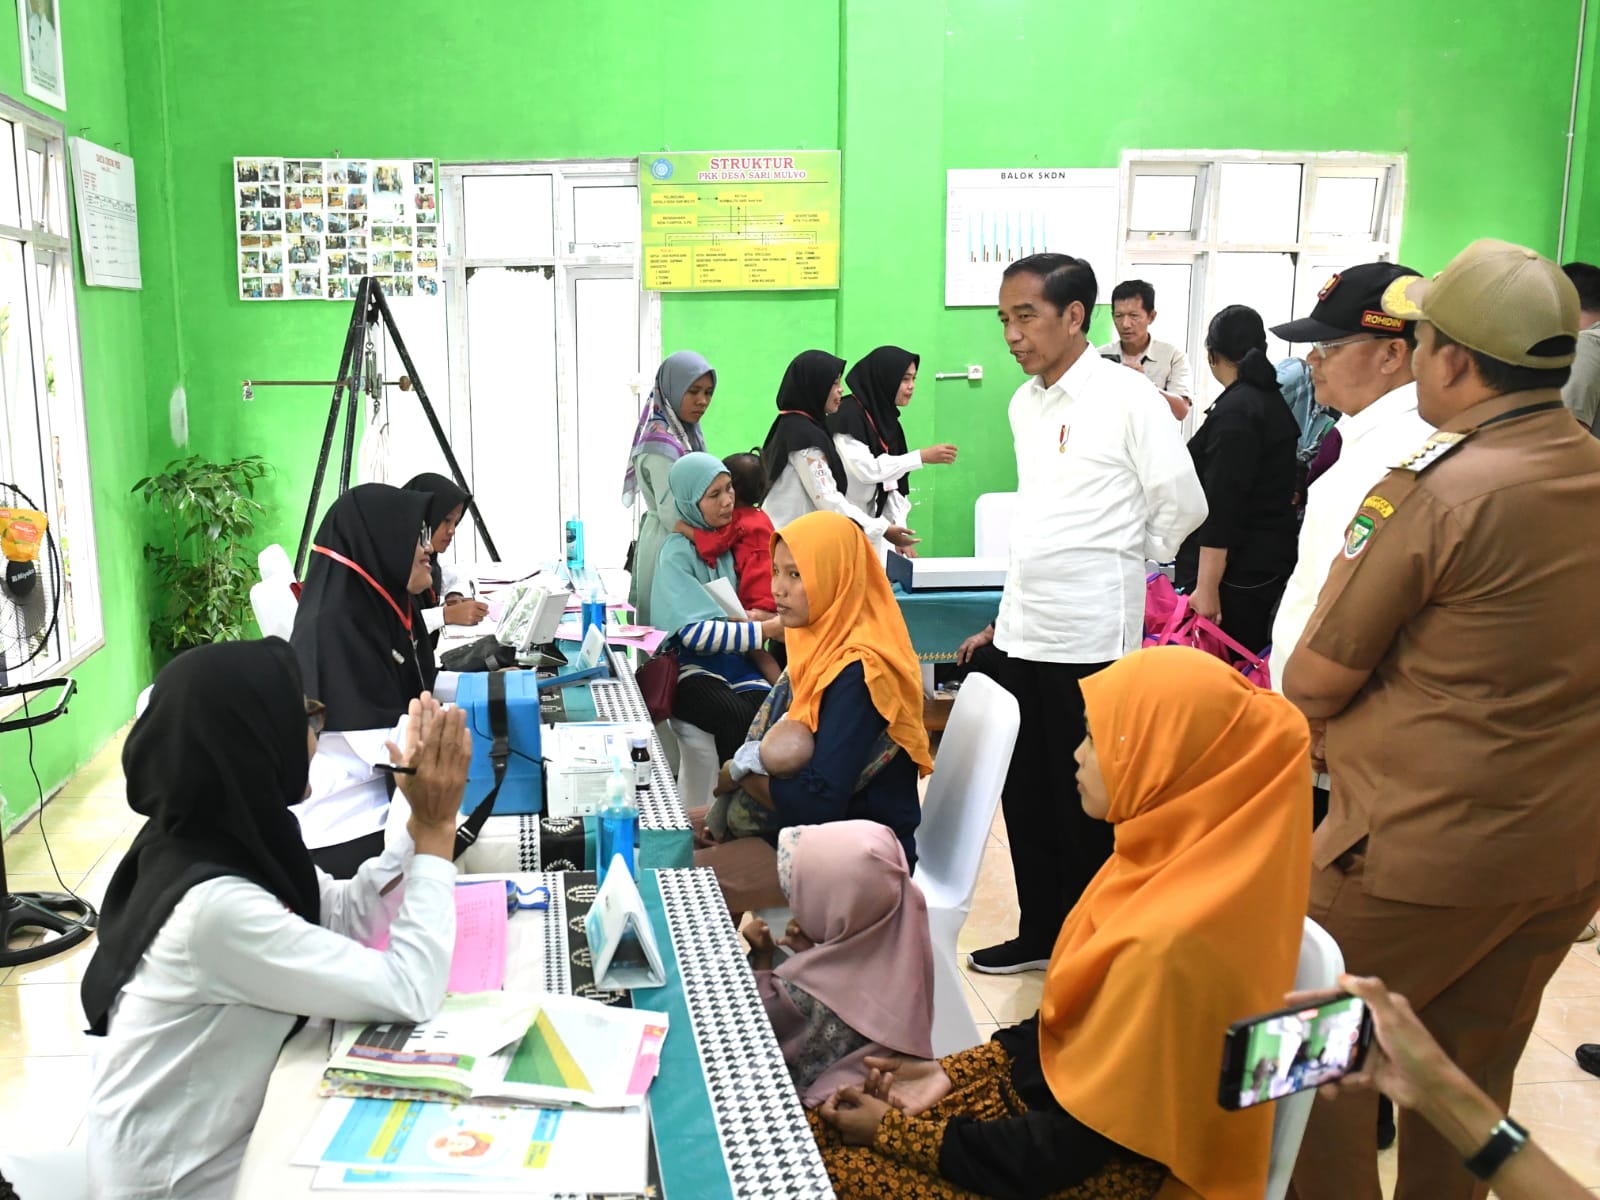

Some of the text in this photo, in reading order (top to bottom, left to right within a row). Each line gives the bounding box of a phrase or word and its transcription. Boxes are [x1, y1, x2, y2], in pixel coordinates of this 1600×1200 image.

[710, 157, 794, 170] STRUKTUR
[699, 170, 806, 180] PKK DESA SARI MULYO
[1000, 171, 1066, 180] BALOK SKDN
[1365, 314, 1401, 328] ROHIDIN
